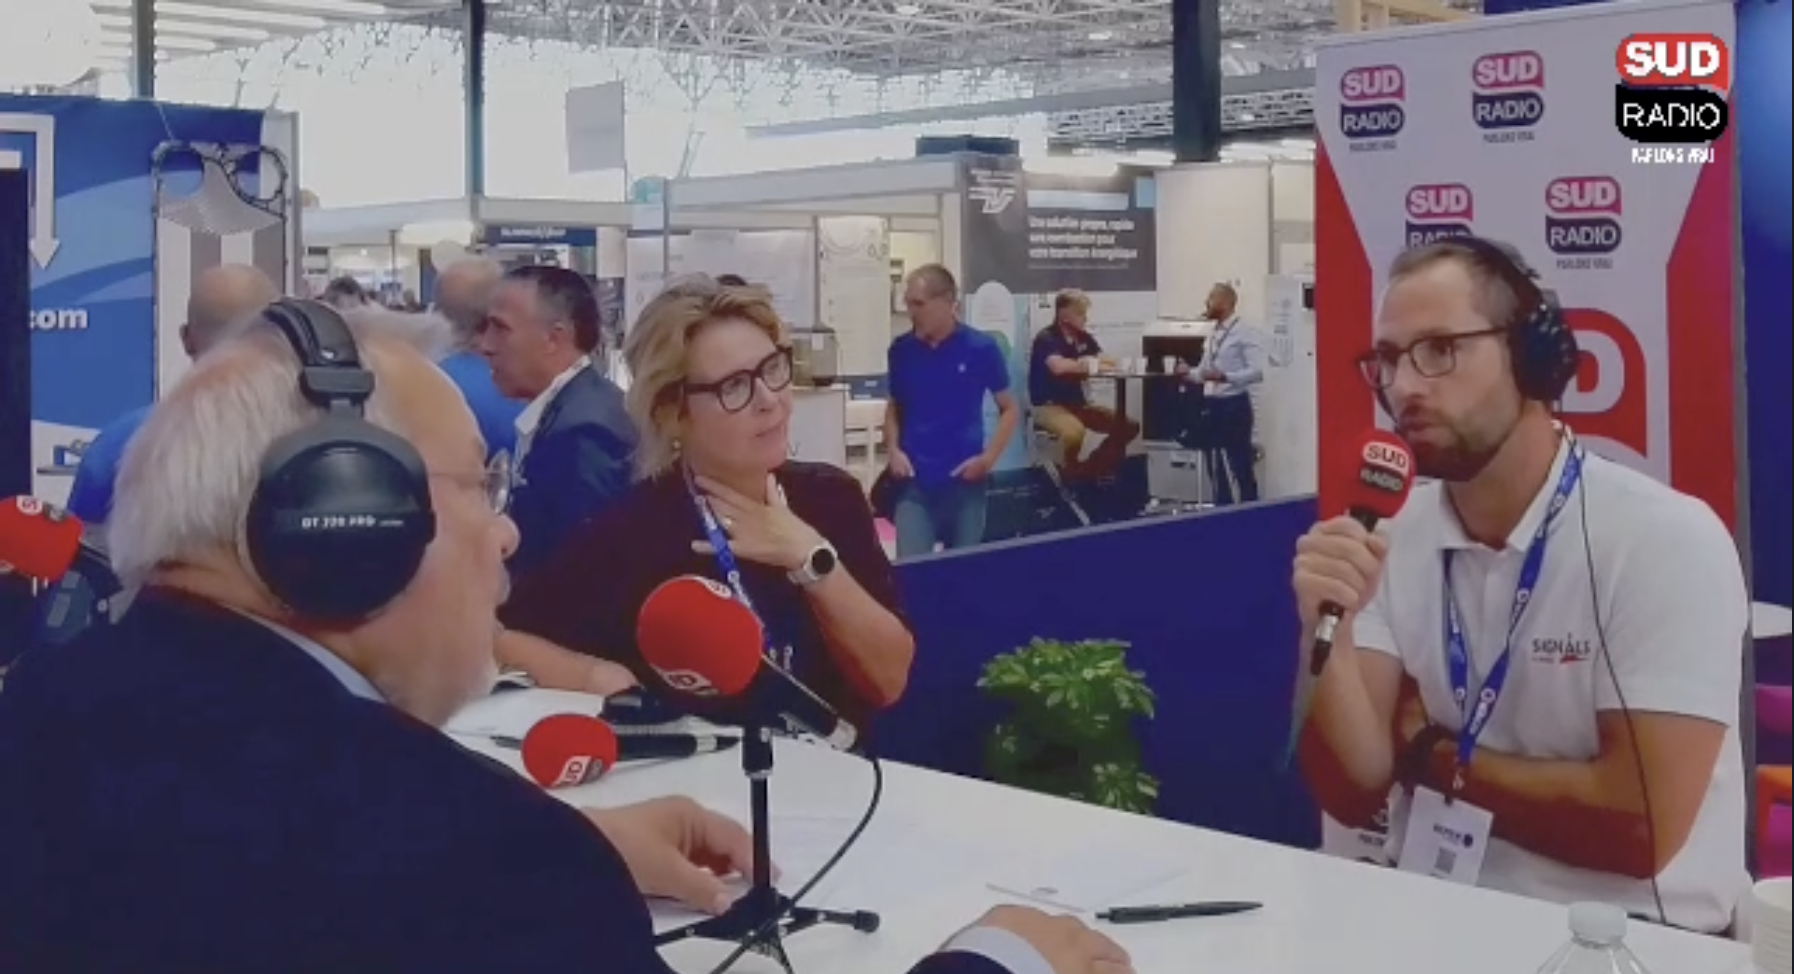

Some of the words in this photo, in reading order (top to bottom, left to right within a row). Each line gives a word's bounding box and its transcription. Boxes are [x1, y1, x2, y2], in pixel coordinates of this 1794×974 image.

[1475, 54, 1539, 84] SUD
[1343, 68, 1401, 97] SUD
[1343, 108, 1401, 133] RADIO
[1475, 97, 1541, 122] RADIO
[1409, 188, 1469, 214] SUD
[1549, 181, 1617, 208] SUD
[1549, 226, 1618, 246] RADIO
[1365, 444, 1406, 469] SUD
